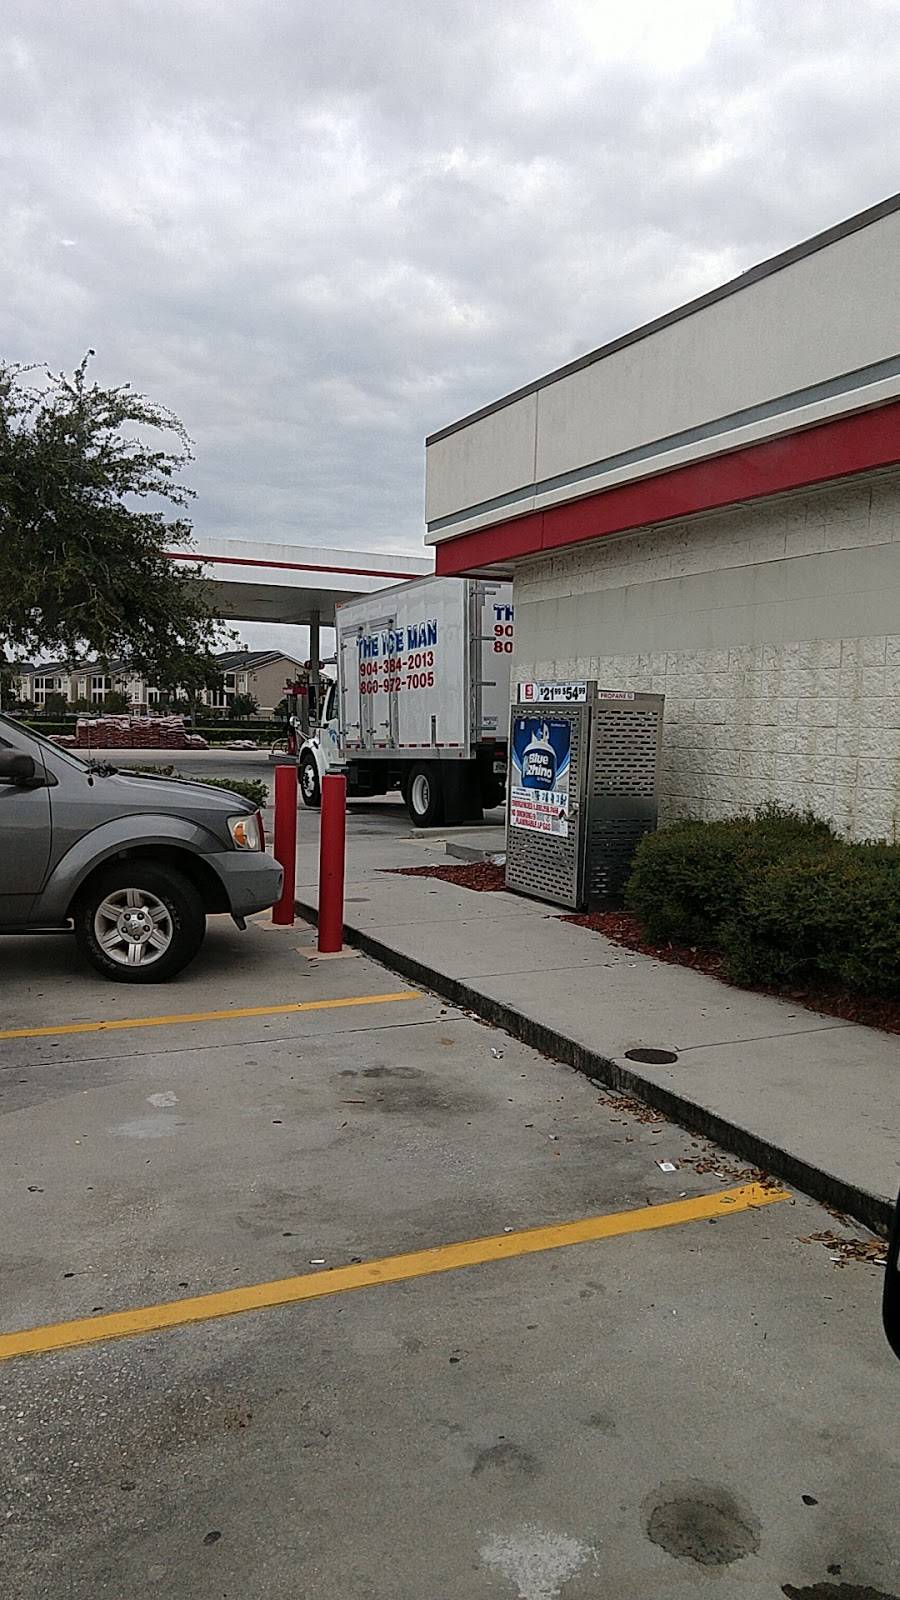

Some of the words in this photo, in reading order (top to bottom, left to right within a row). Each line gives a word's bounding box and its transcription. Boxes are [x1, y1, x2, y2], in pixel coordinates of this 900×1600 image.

[356, 634, 379, 659] THE
[381, 627, 404, 655] ICE
[407, 619, 438, 650] MAN
[359, 651, 434, 677] 904-384-2013
[360, 671, 434, 695] 800-972-7005
[600, 692, 626, 700] PROPANE
[528, 752, 549, 765] Blue
[526, 764, 552, 777] Rhino
